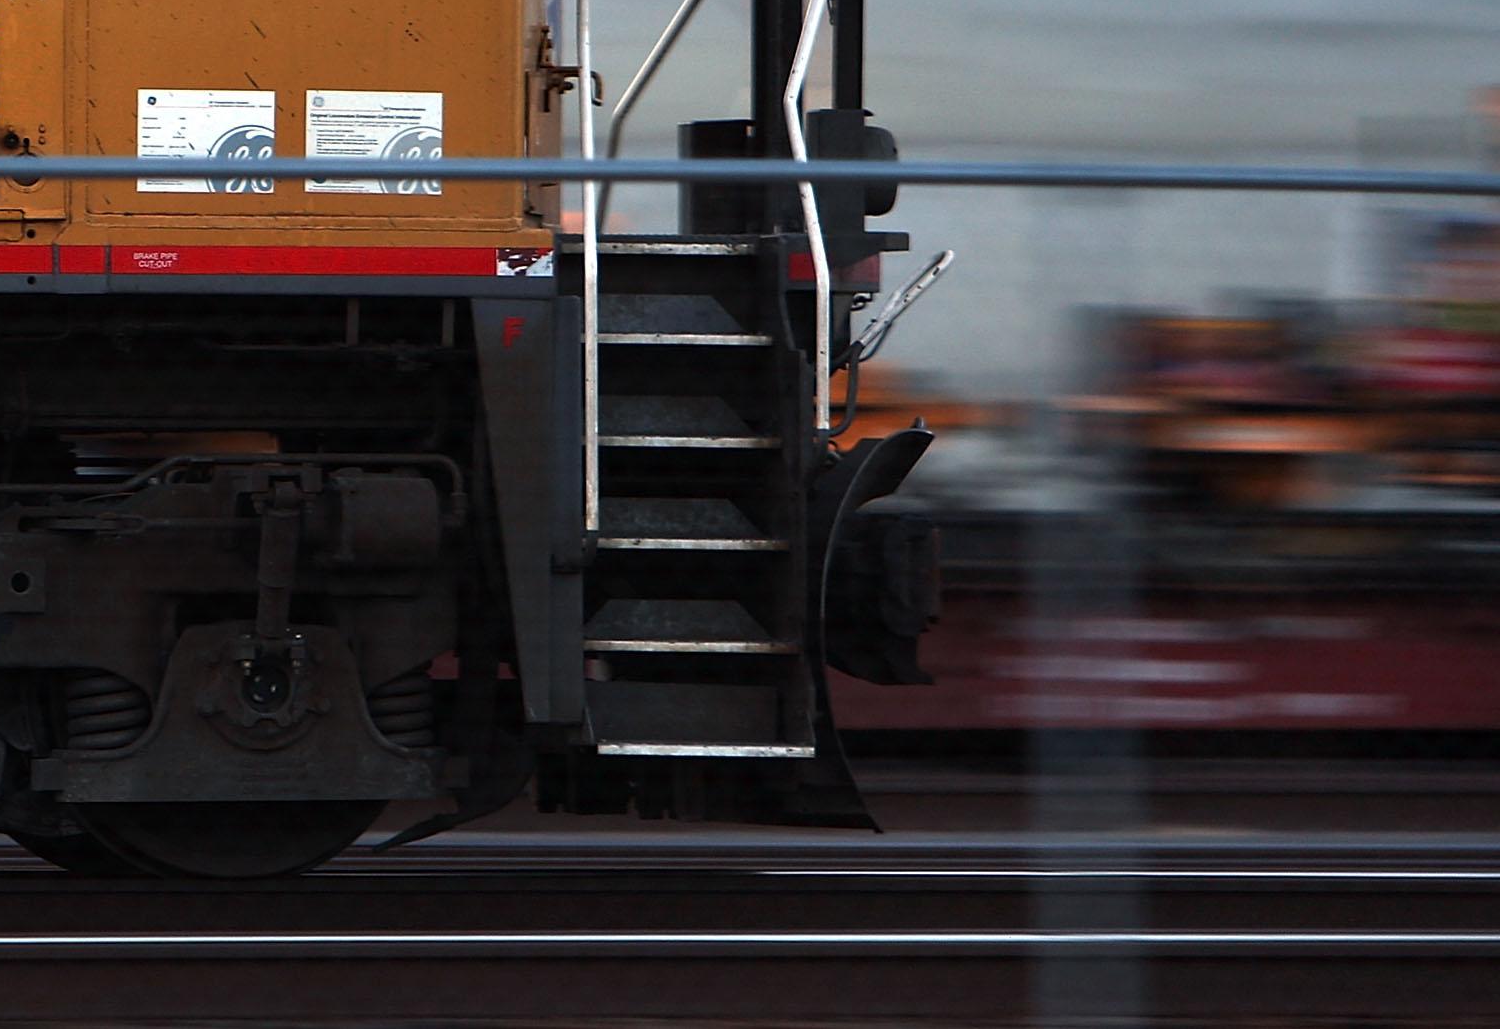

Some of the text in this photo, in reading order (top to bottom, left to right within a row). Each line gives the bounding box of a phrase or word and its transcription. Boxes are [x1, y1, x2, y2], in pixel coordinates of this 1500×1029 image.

[133, 252, 178, 260] BRAKE PIPE
[504, 316, 527, 348] F
